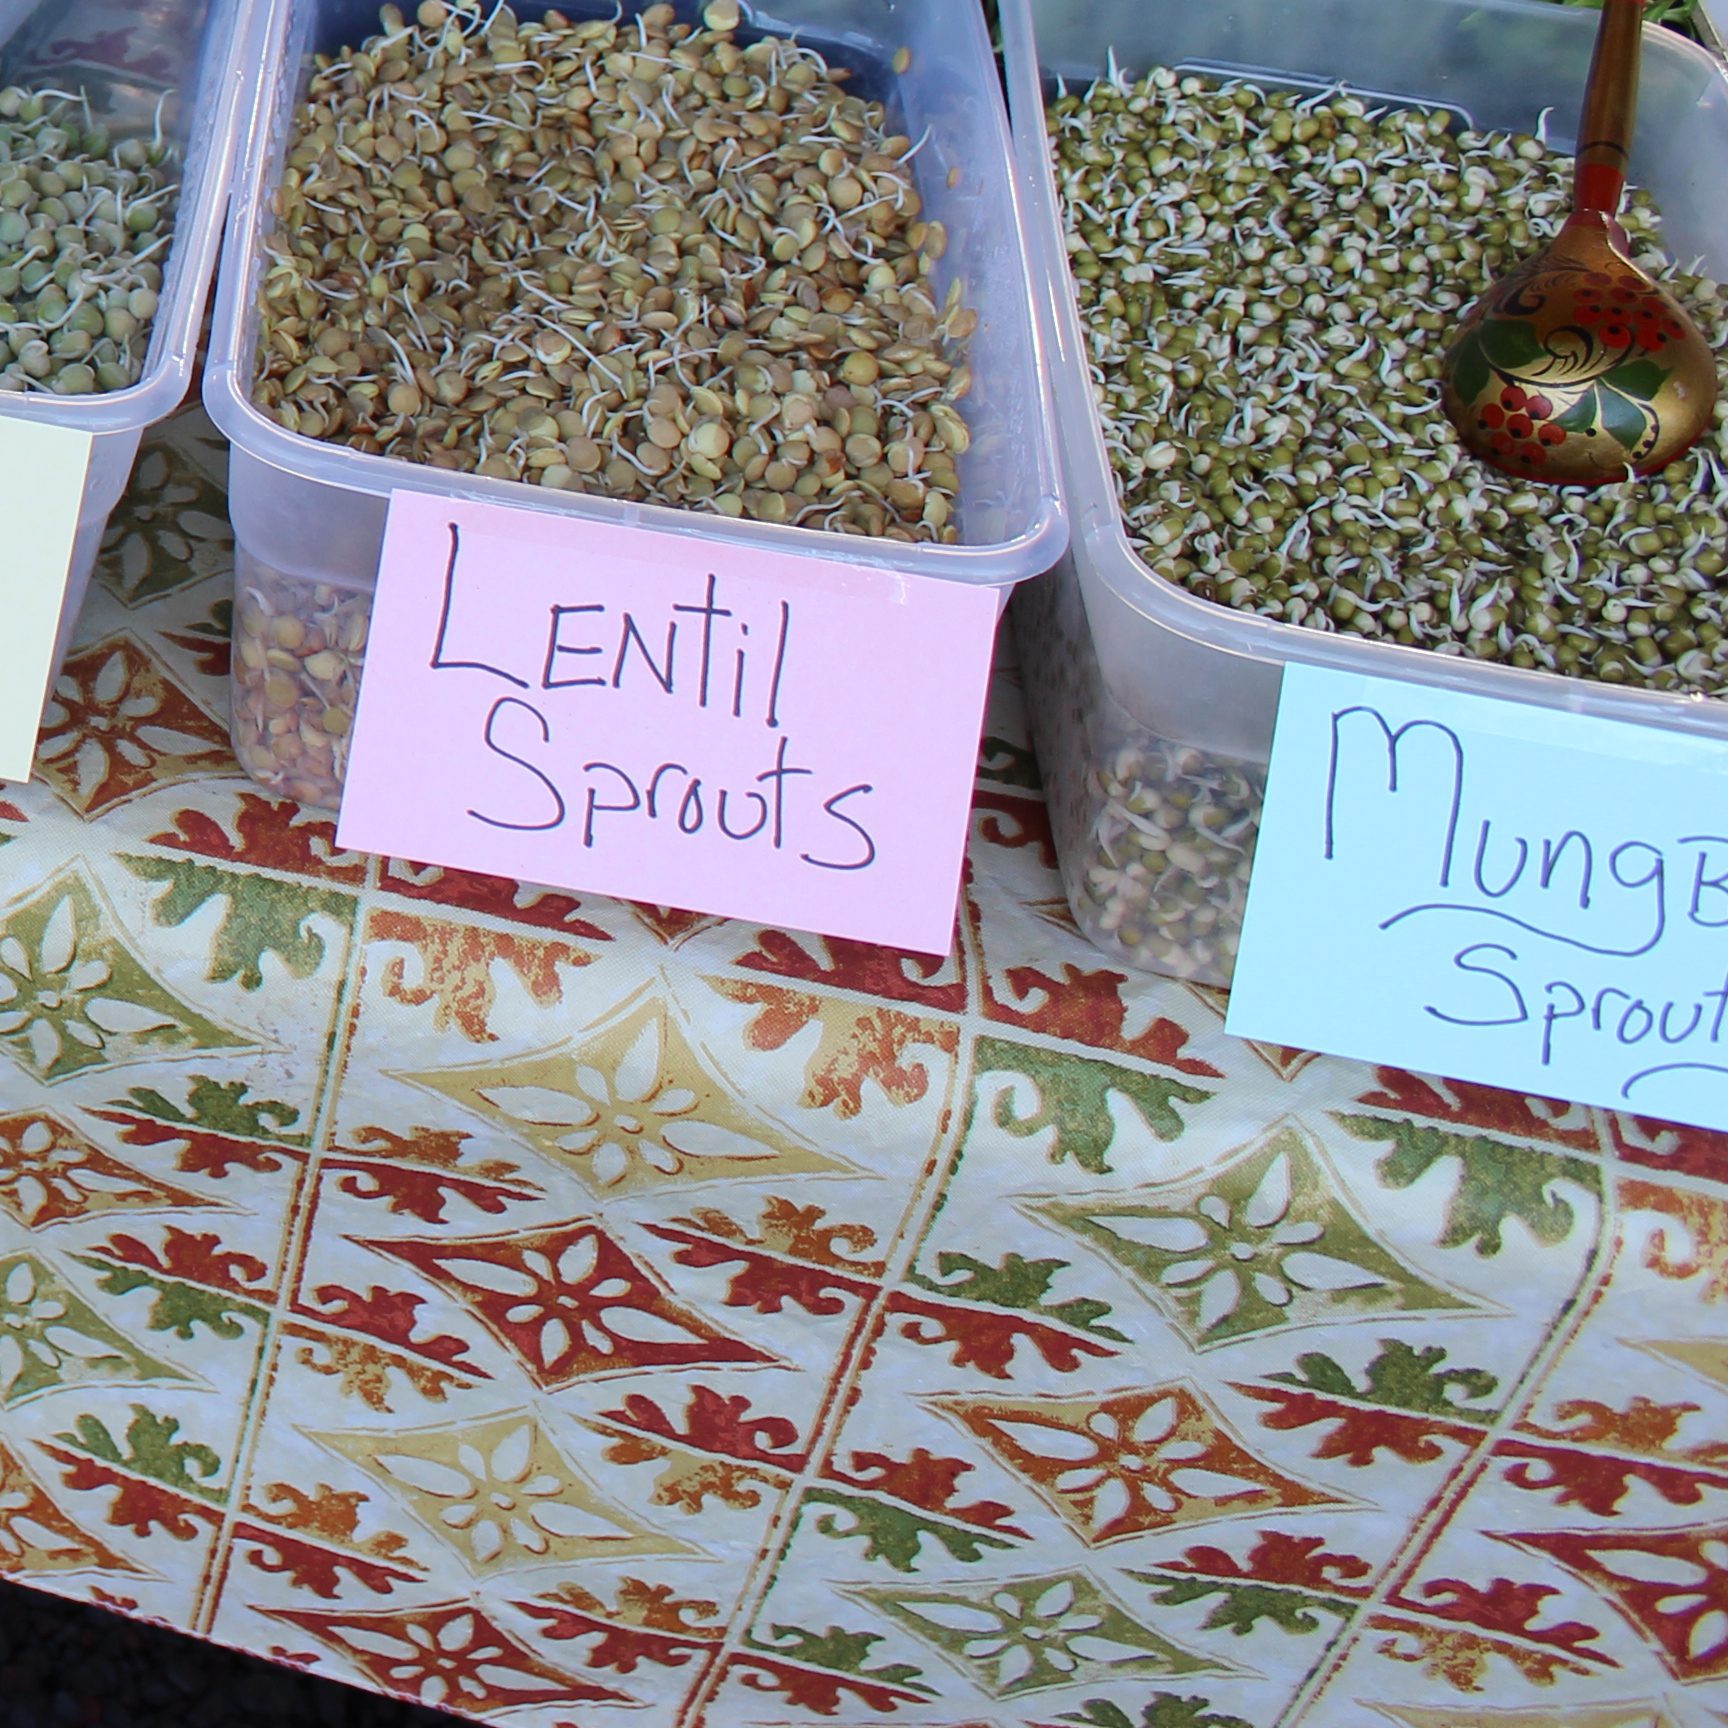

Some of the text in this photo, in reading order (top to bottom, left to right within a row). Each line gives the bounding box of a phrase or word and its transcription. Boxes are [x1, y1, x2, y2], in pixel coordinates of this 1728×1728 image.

[466, 695, 877, 871] Sprouts
[1322, 705, 1667, 958] Mung
[1422, 943, 1728, 1101] Sprout
